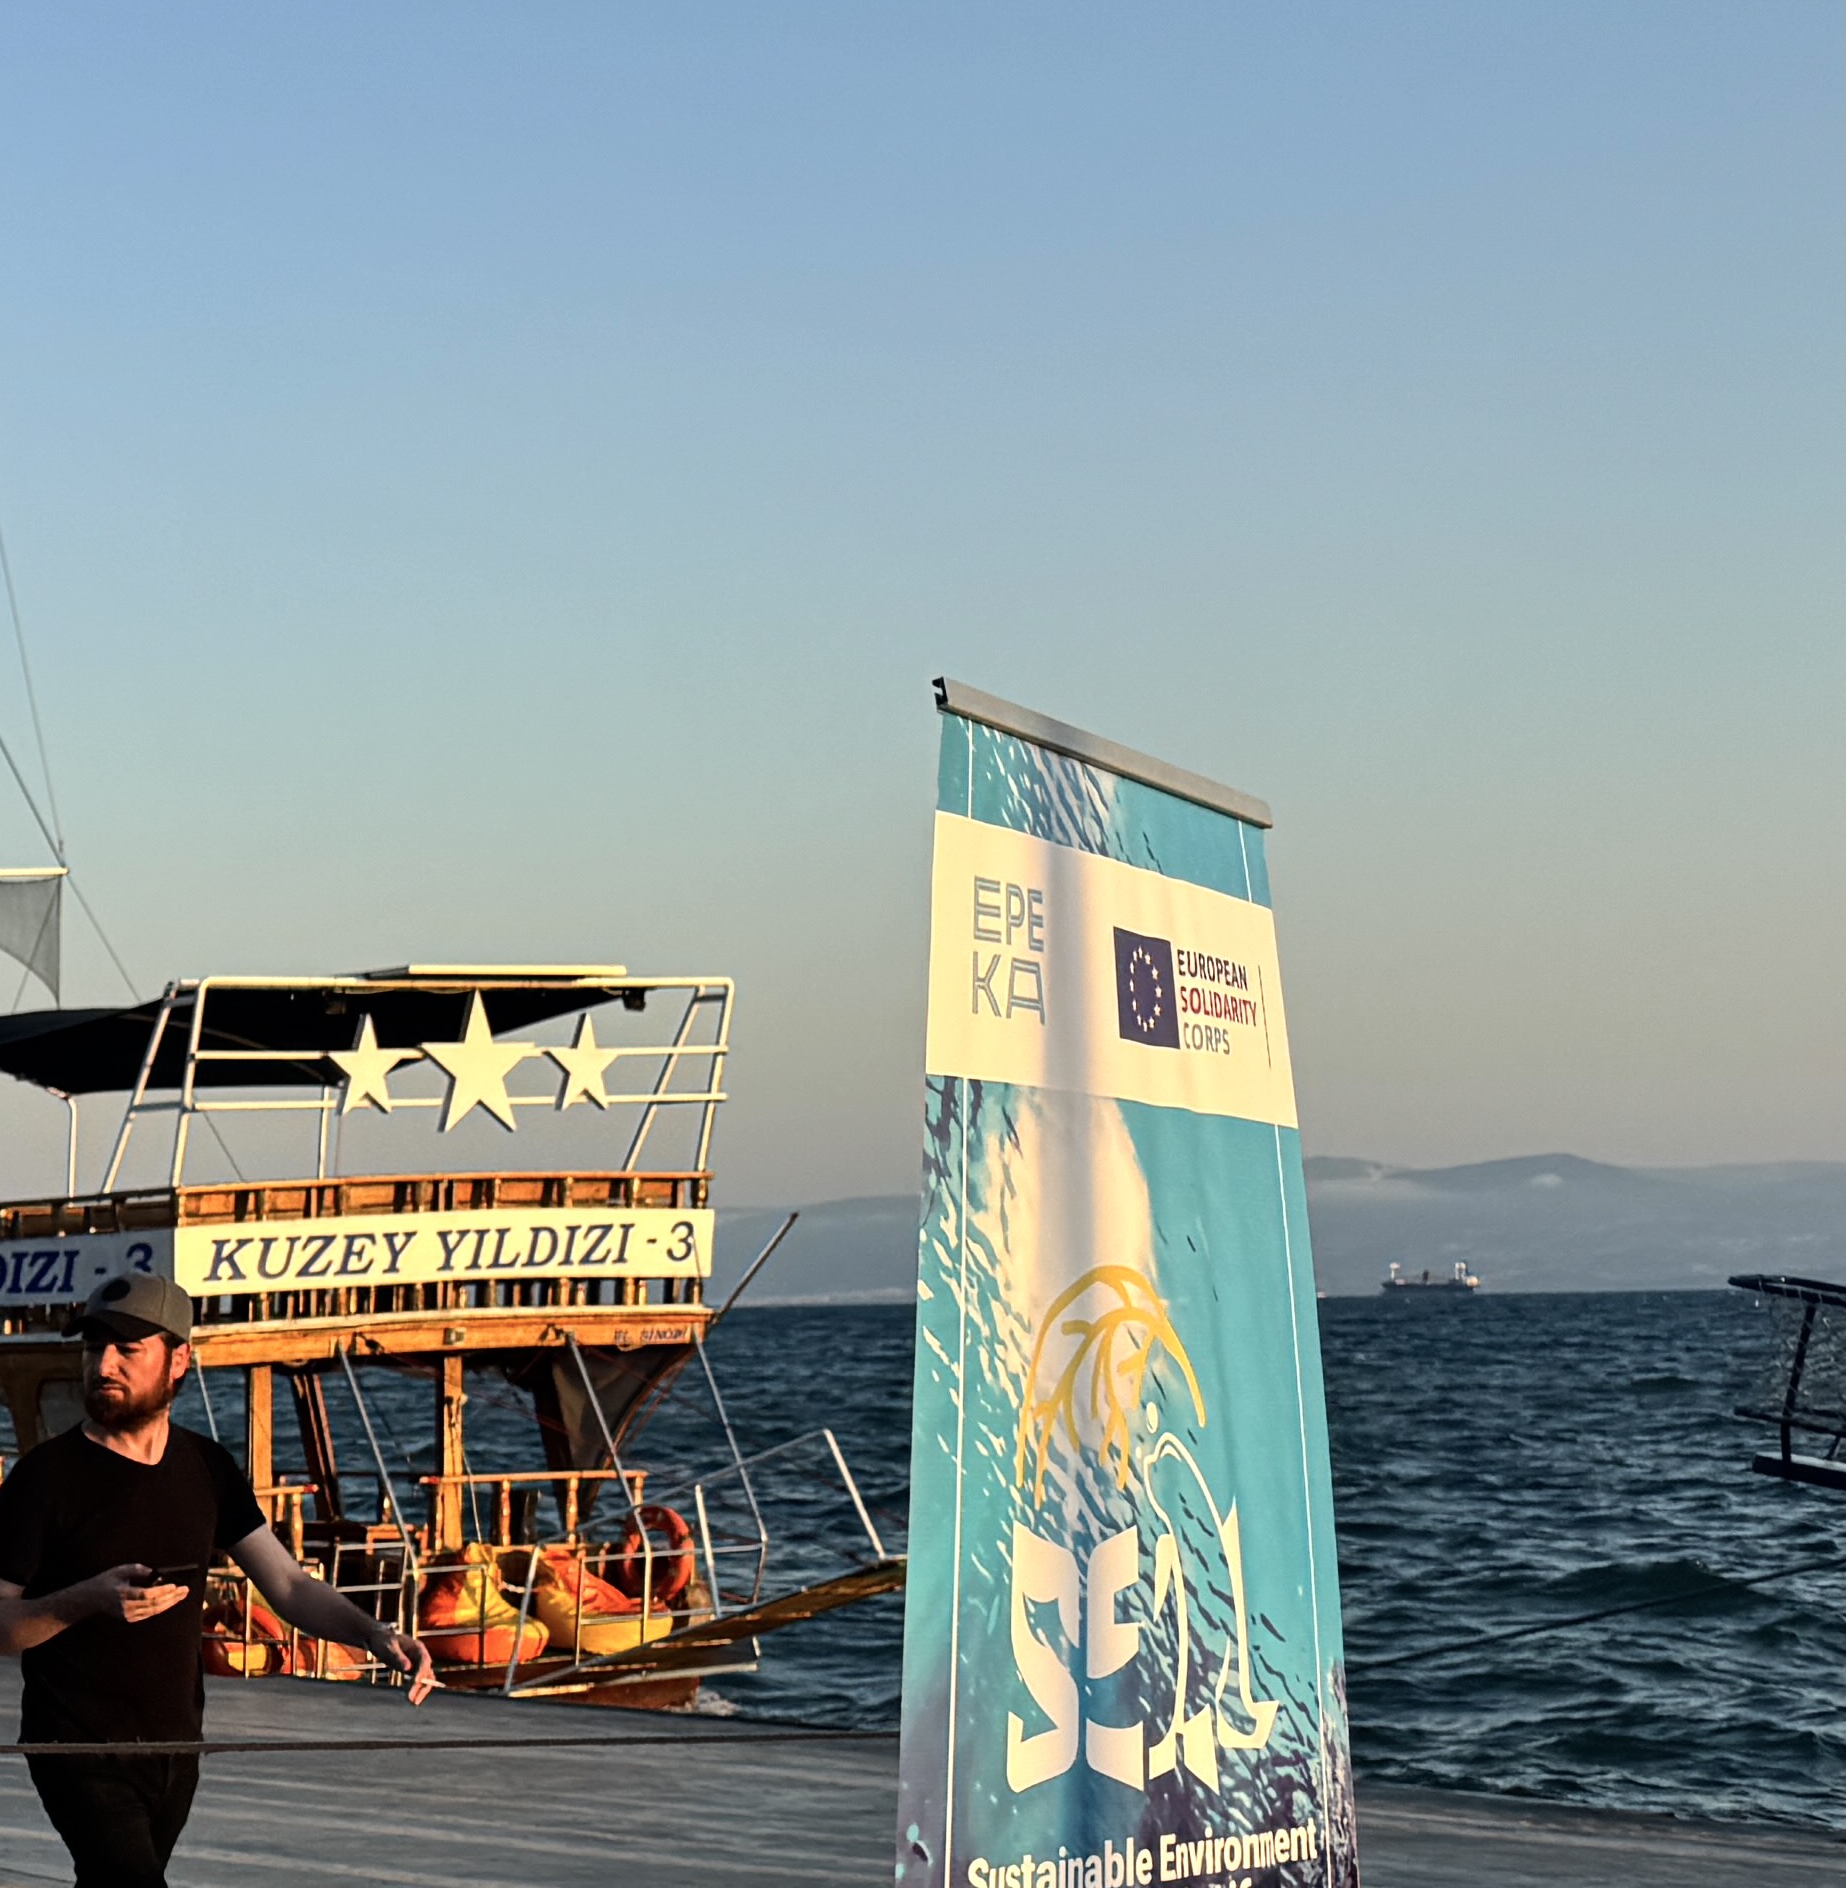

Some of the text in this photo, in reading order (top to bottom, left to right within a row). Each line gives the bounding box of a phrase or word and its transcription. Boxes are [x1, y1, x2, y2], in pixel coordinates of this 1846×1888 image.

[973, 874, 1045, 952] EPE
[972, 951, 1046, 1026] KA
[1176, 948, 1248, 991] EUROPEAN
[1180, 985, 1257, 1028] SOLIDARITY
[1183, 1021, 1231, 1056] CORPS
[203, 1230, 417, 1283] KUZEY
[435, 1222, 636, 1273] YILDIZI
[1159, 1817, 1319, 1882] Environment
